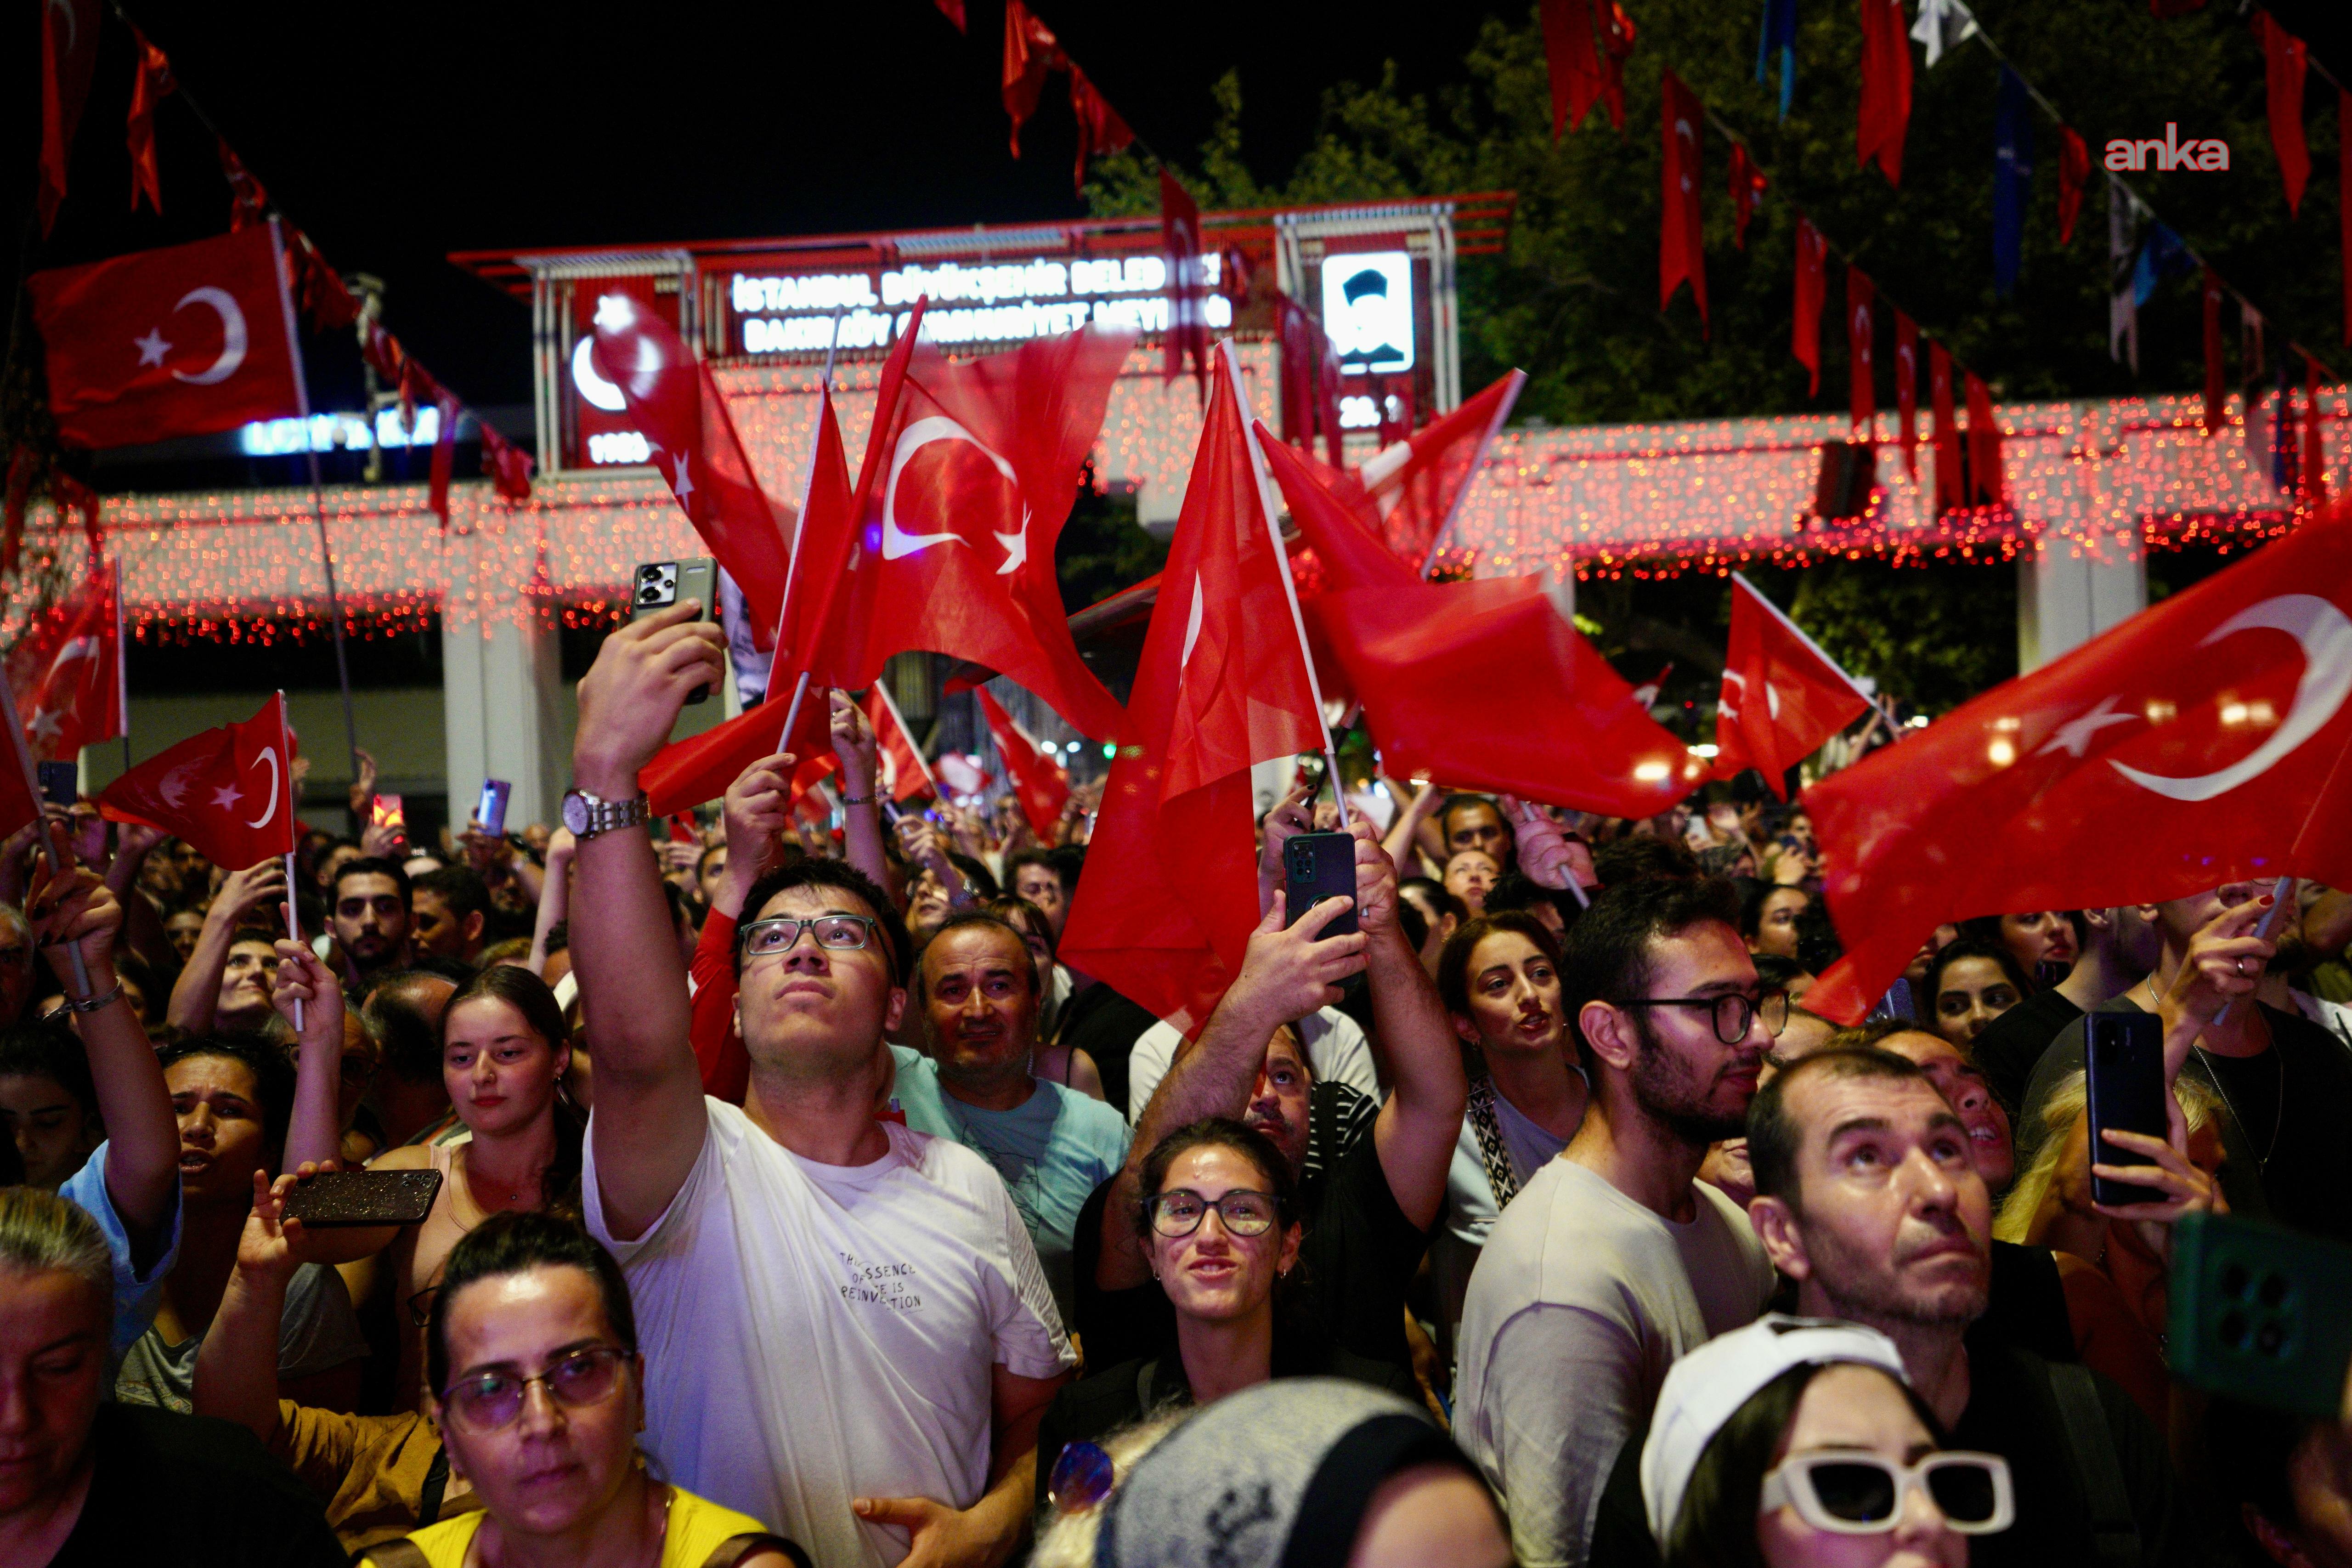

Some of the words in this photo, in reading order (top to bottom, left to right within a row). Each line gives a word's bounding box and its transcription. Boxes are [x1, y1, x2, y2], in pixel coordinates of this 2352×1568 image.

[865, 1263, 916, 1279] SSENCE
[853, 1273, 865, 1285] OF
[893, 1282, 904, 1293] IS
